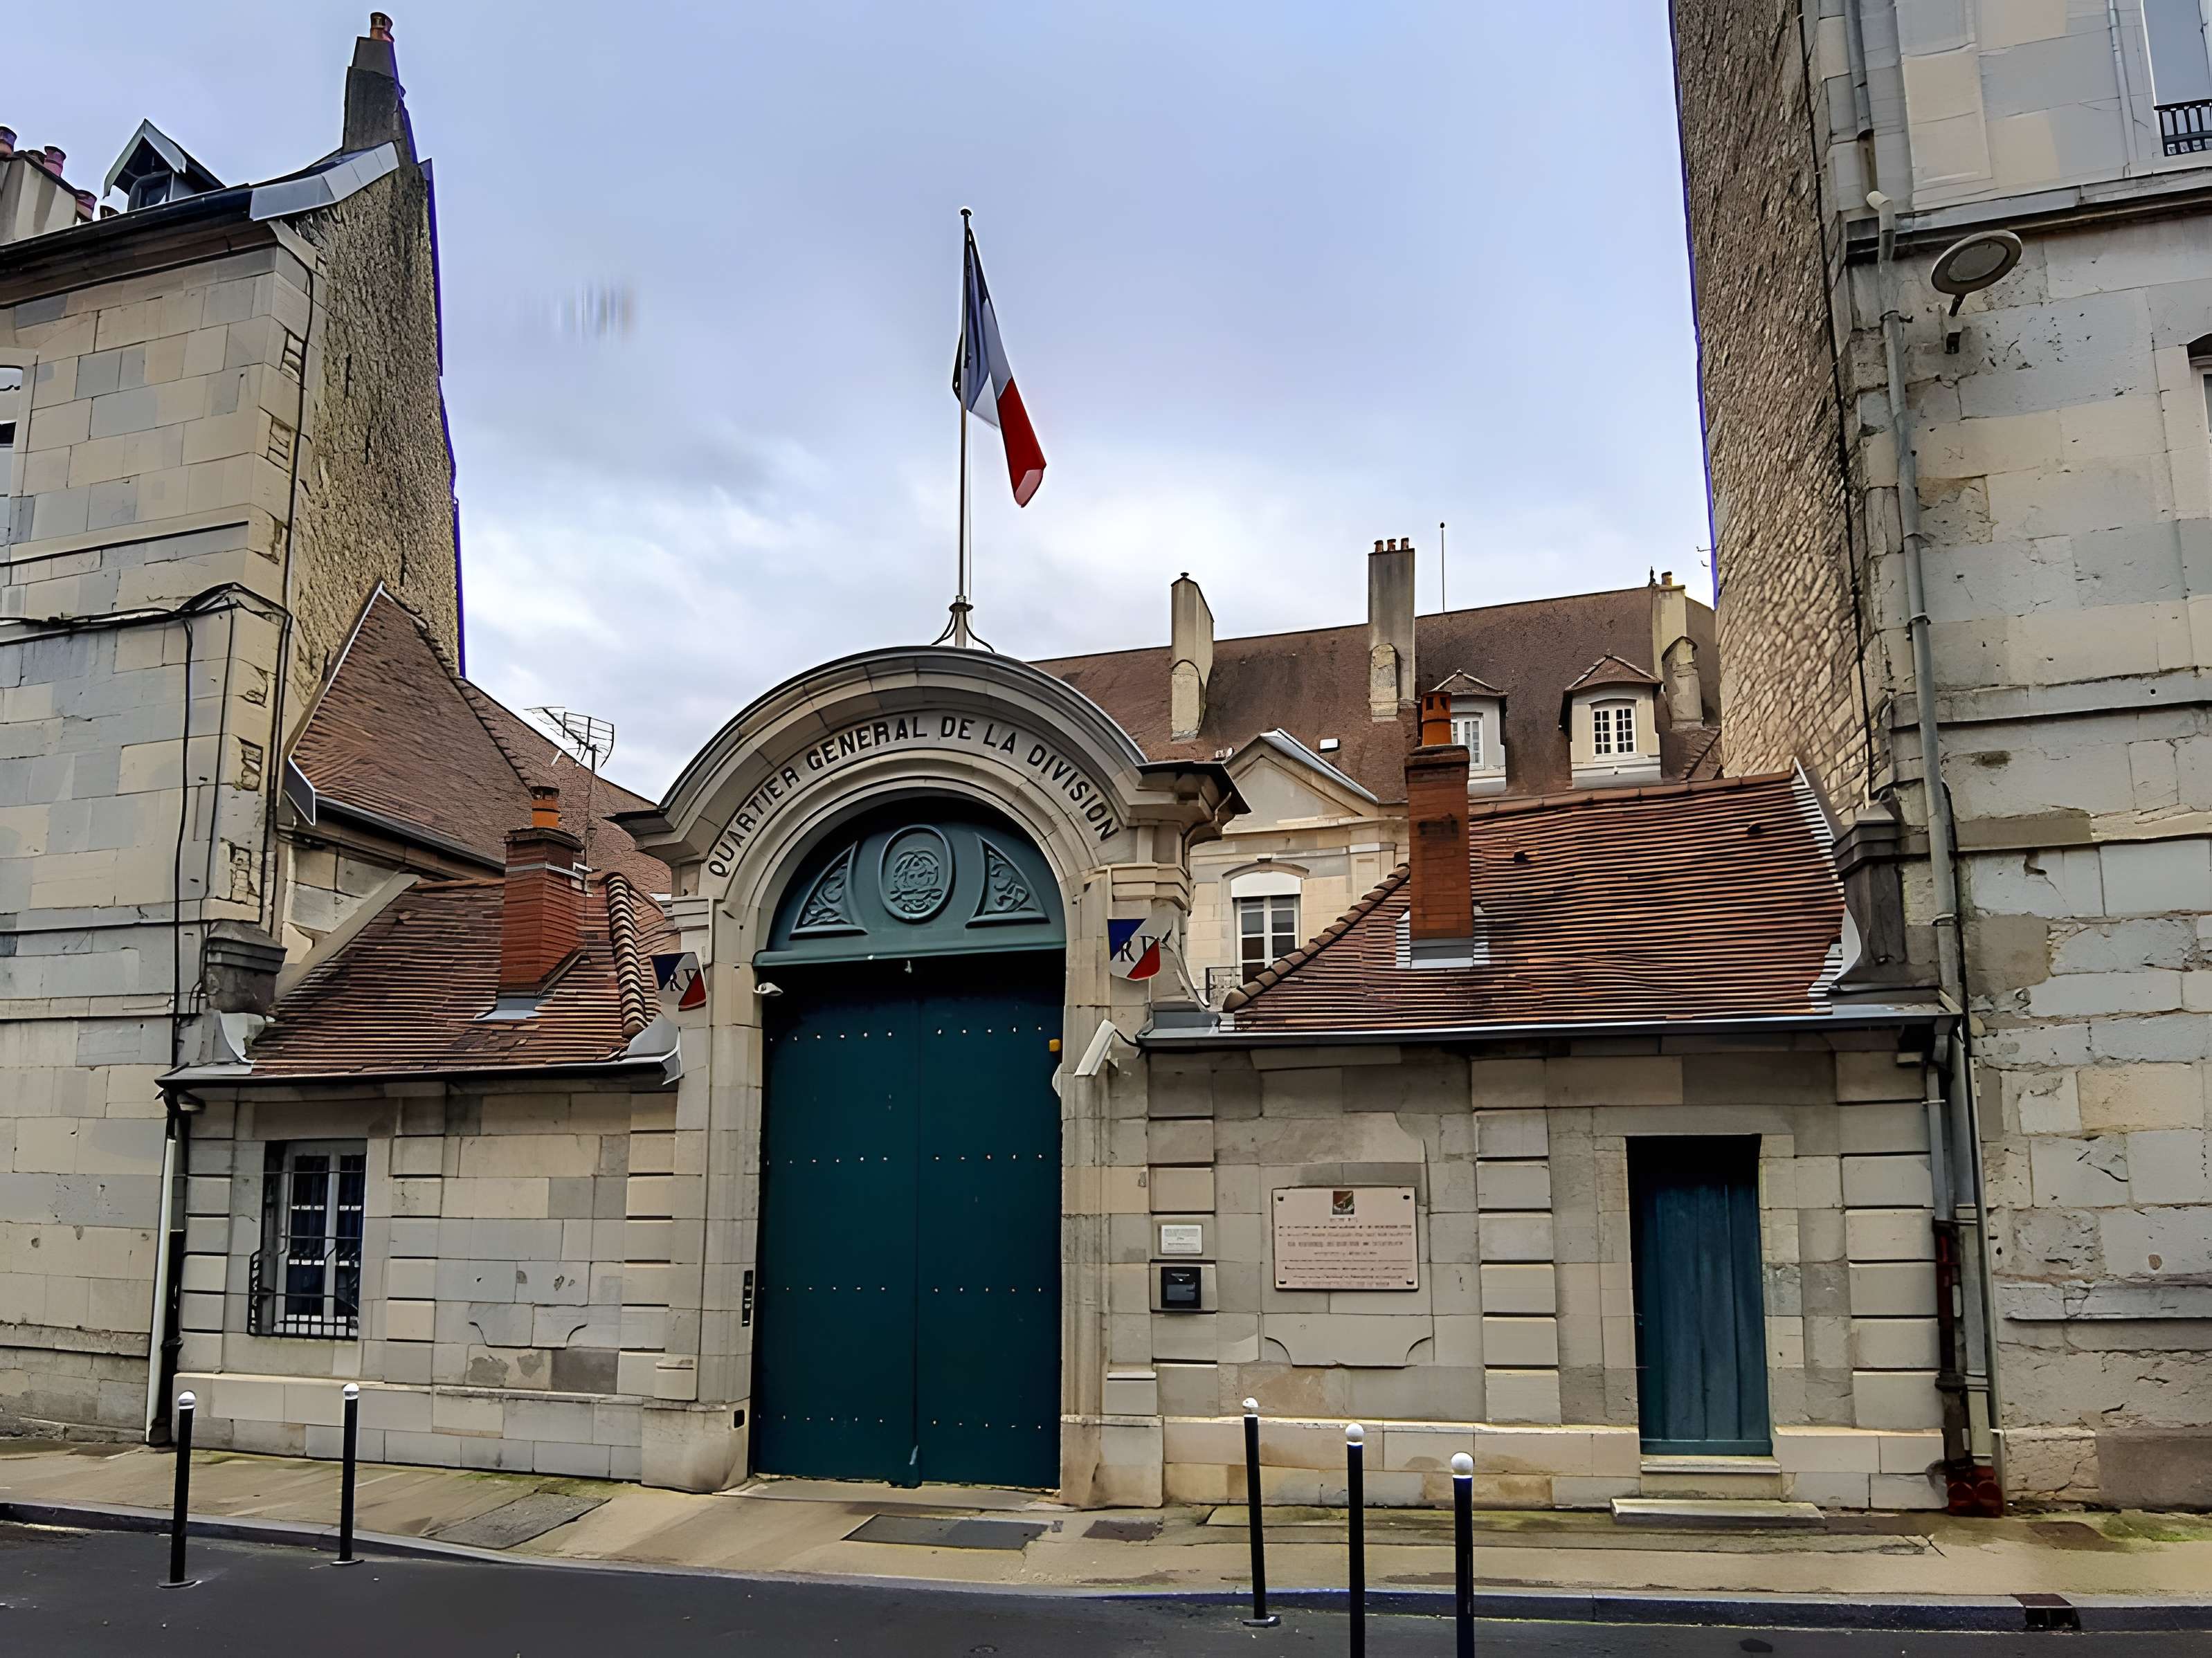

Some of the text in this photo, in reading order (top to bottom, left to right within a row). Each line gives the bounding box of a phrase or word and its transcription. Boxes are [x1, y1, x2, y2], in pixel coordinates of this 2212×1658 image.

[708, 716, 1120, 878] QUARTIER GENERAL DE LA DIVISION
